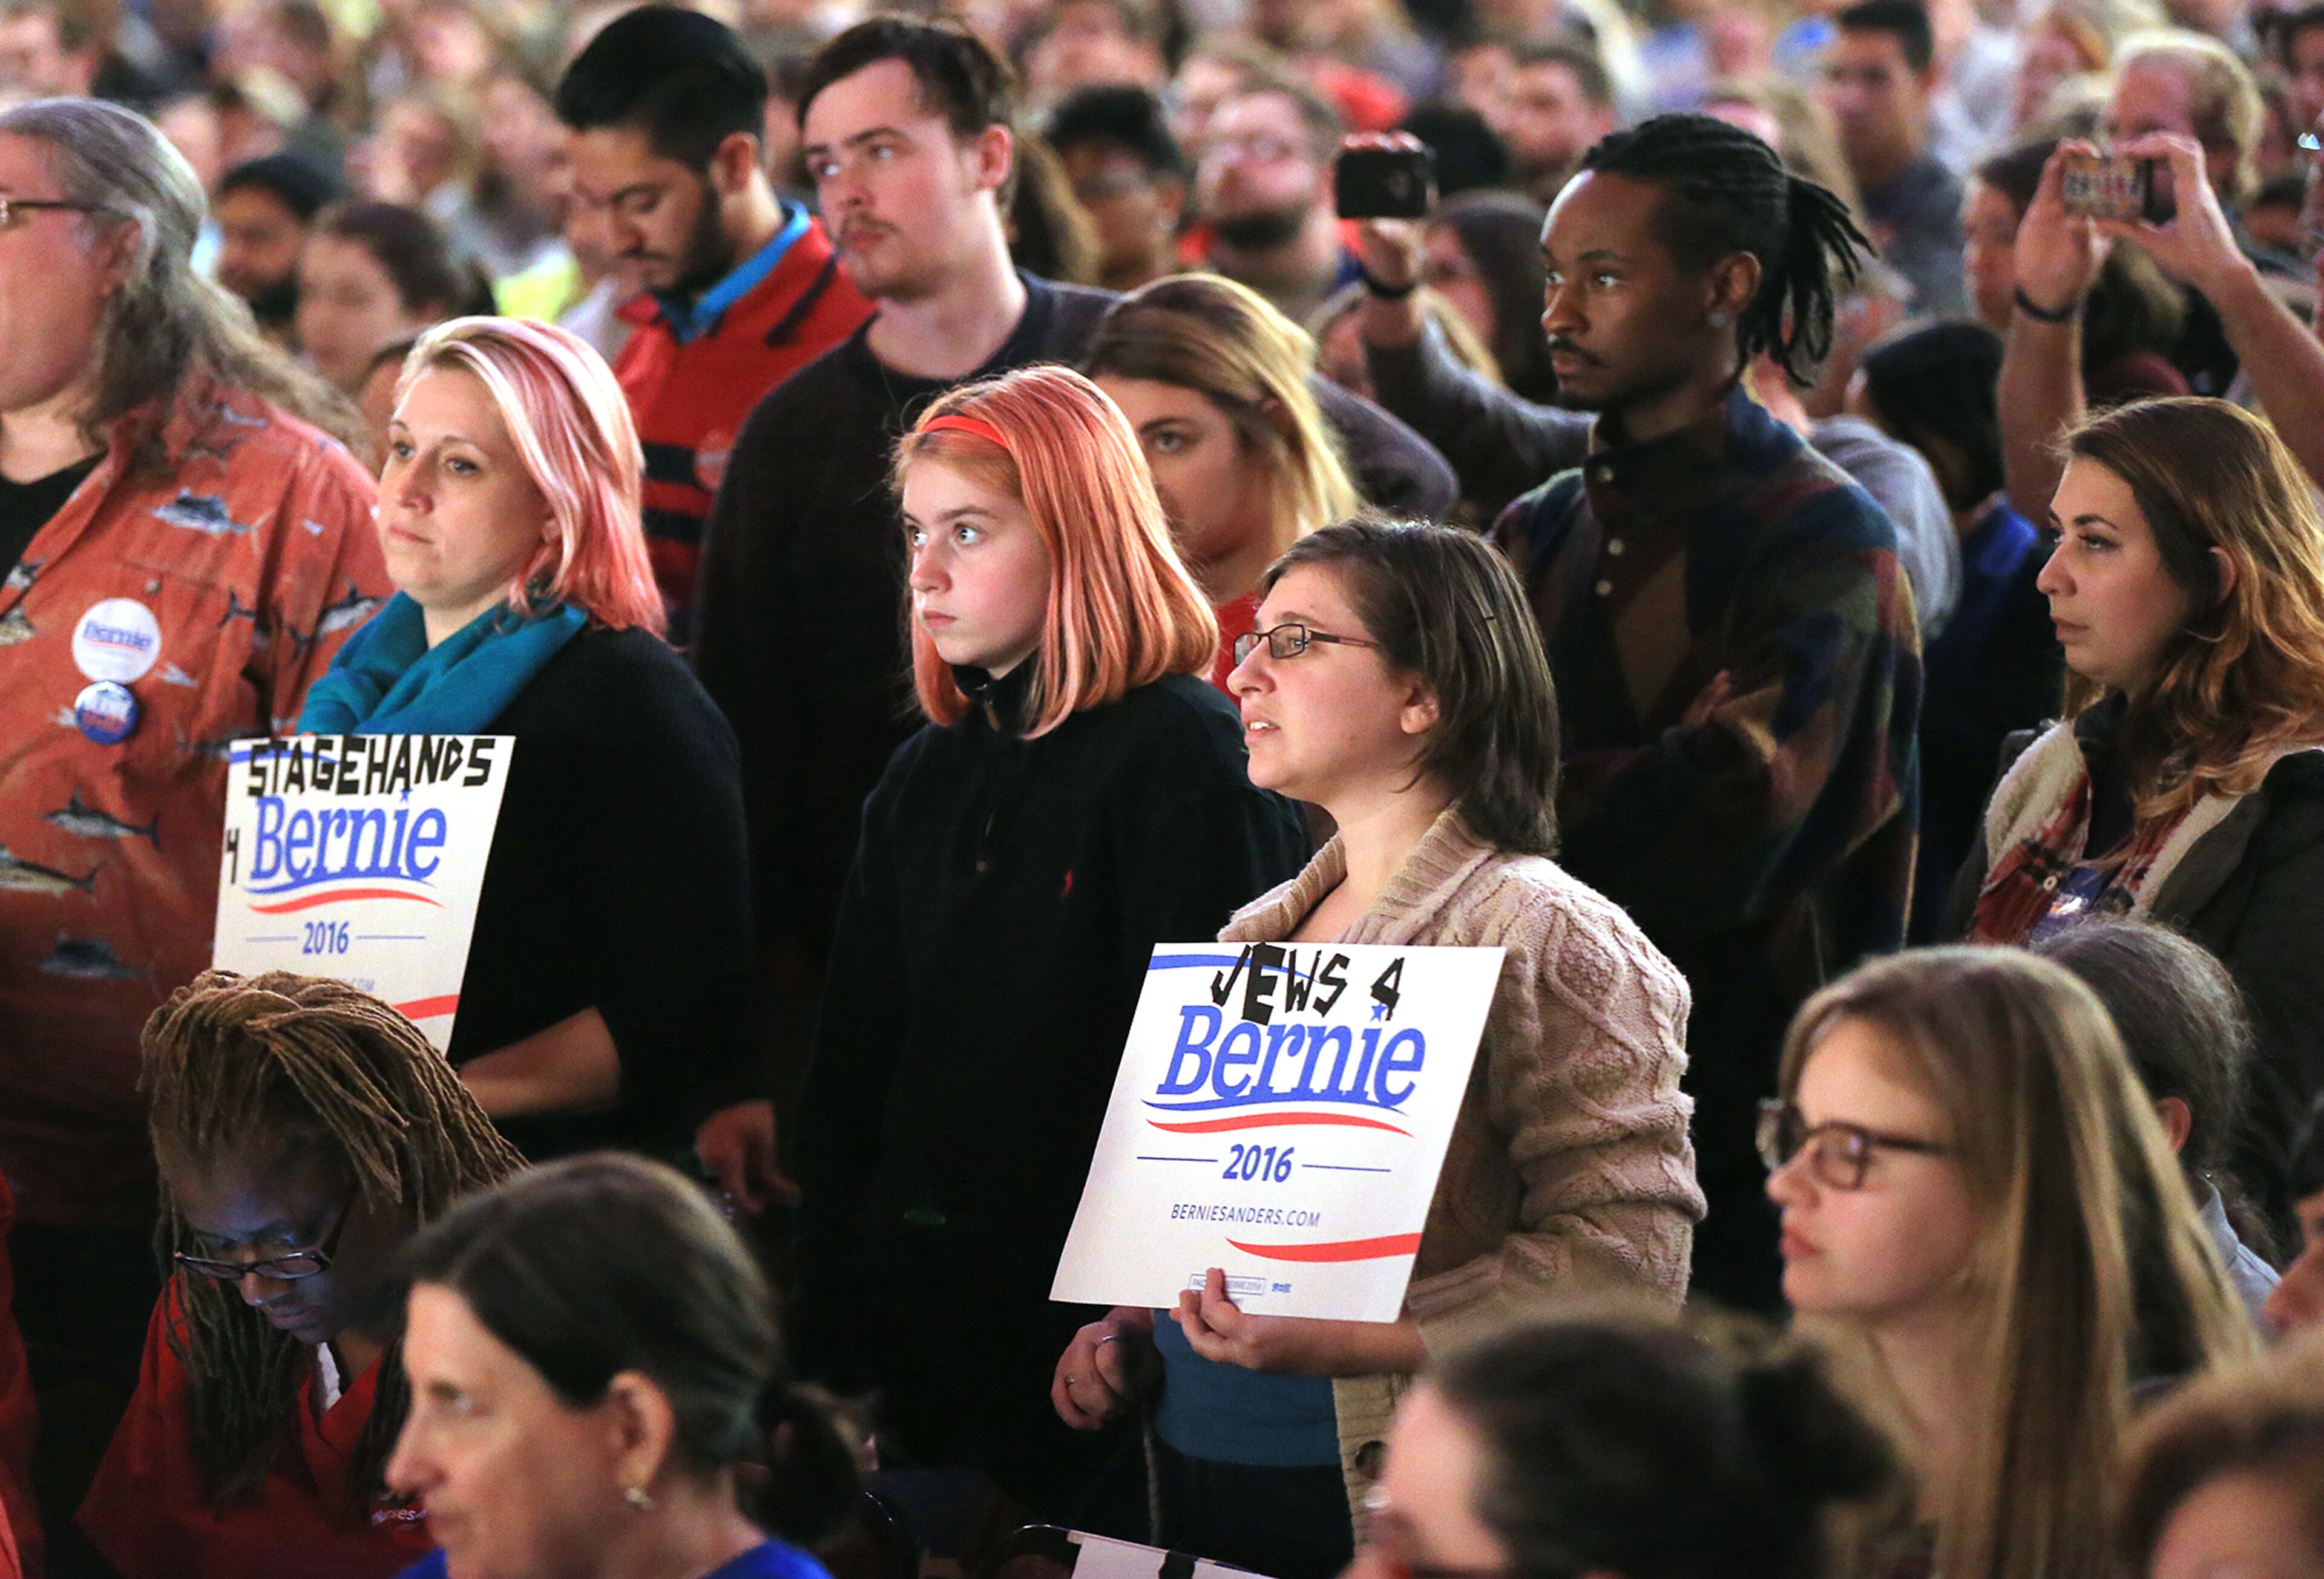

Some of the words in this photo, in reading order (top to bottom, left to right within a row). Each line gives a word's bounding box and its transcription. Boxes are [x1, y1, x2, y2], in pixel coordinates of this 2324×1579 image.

[248, 734, 496, 796] STAGEHANDS
[226, 828, 239, 884] 4
[250, 789, 447, 880] Bernie
[303, 922, 349, 954] 2016
[1210, 942, 1350, 1025] JEWS
[1370, 957, 1405, 1020] 4
[1157, 1002, 1426, 1108] Bernie
[1223, 1144, 1295, 1183] 2016
[1171, 1204, 1321, 1227] BERNIESANDERS.COM
